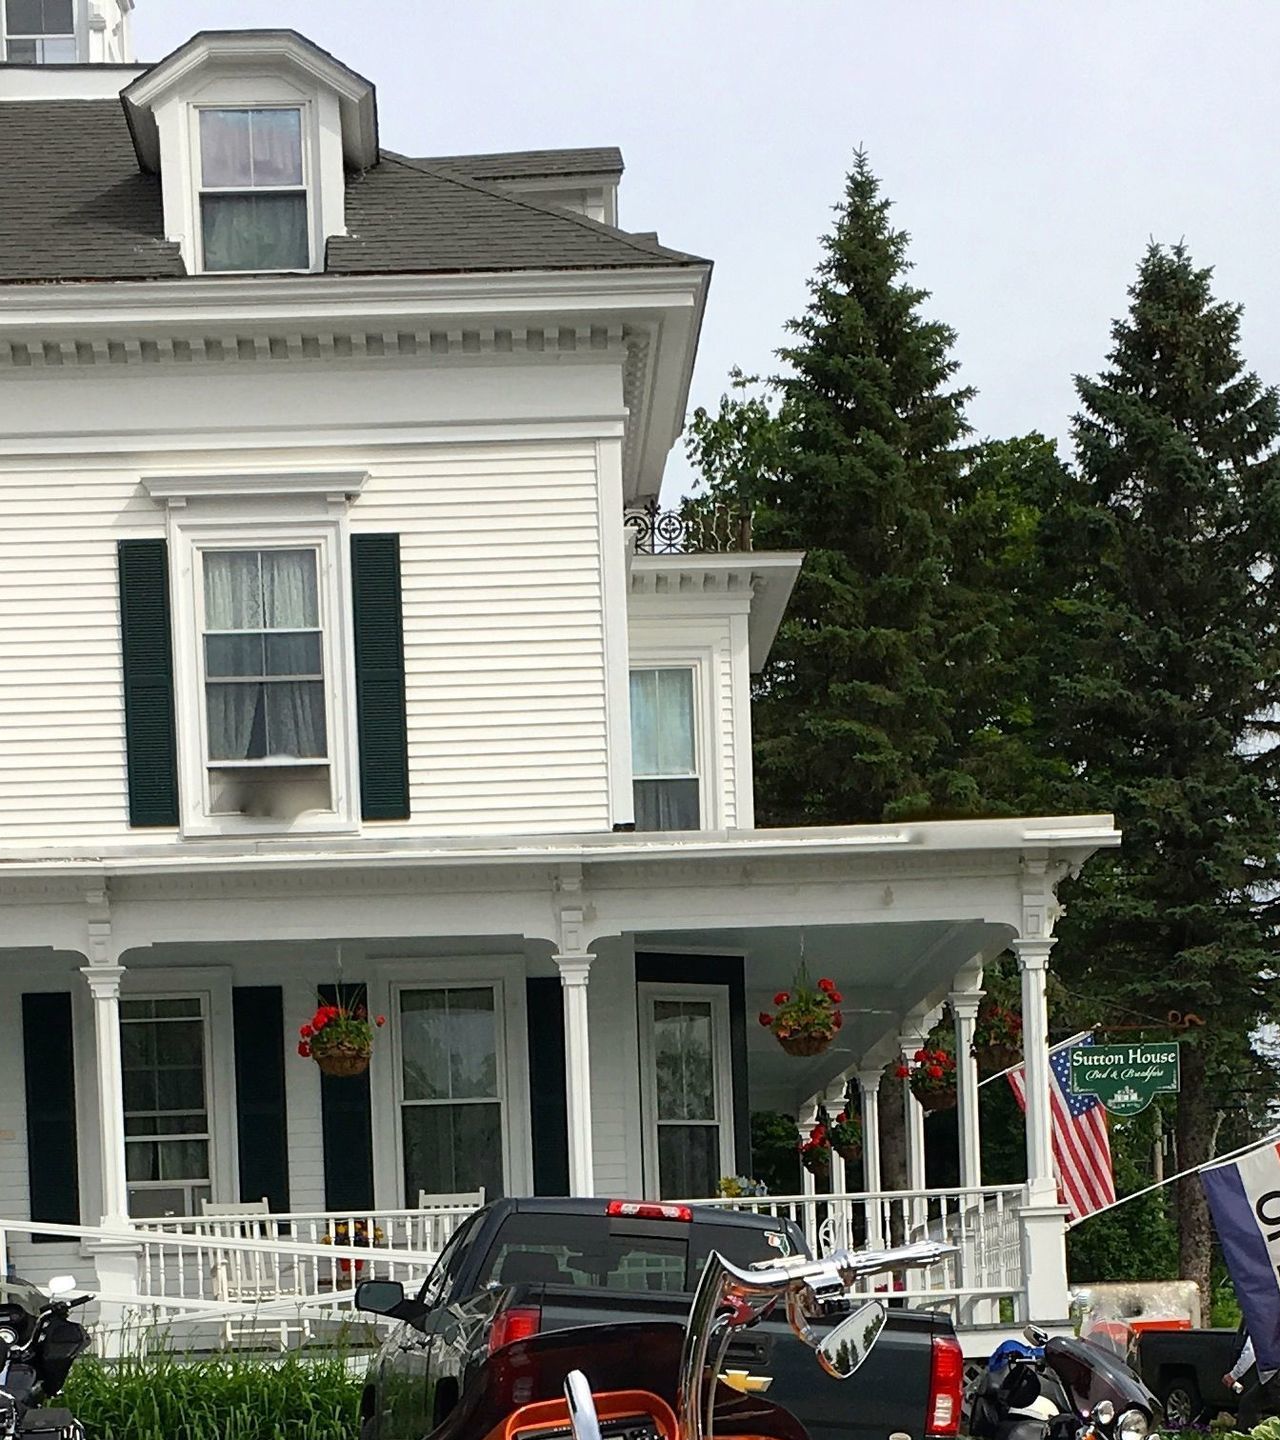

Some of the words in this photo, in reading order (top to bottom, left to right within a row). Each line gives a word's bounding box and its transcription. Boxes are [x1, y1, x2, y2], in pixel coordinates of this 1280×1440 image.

[1072, 1051, 1124, 1066] Sutton
[1128, 1048, 1176, 1064] House
[1085, 1066, 1113, 1081] Bed
[1110, 1070, 1119, 1080] &
